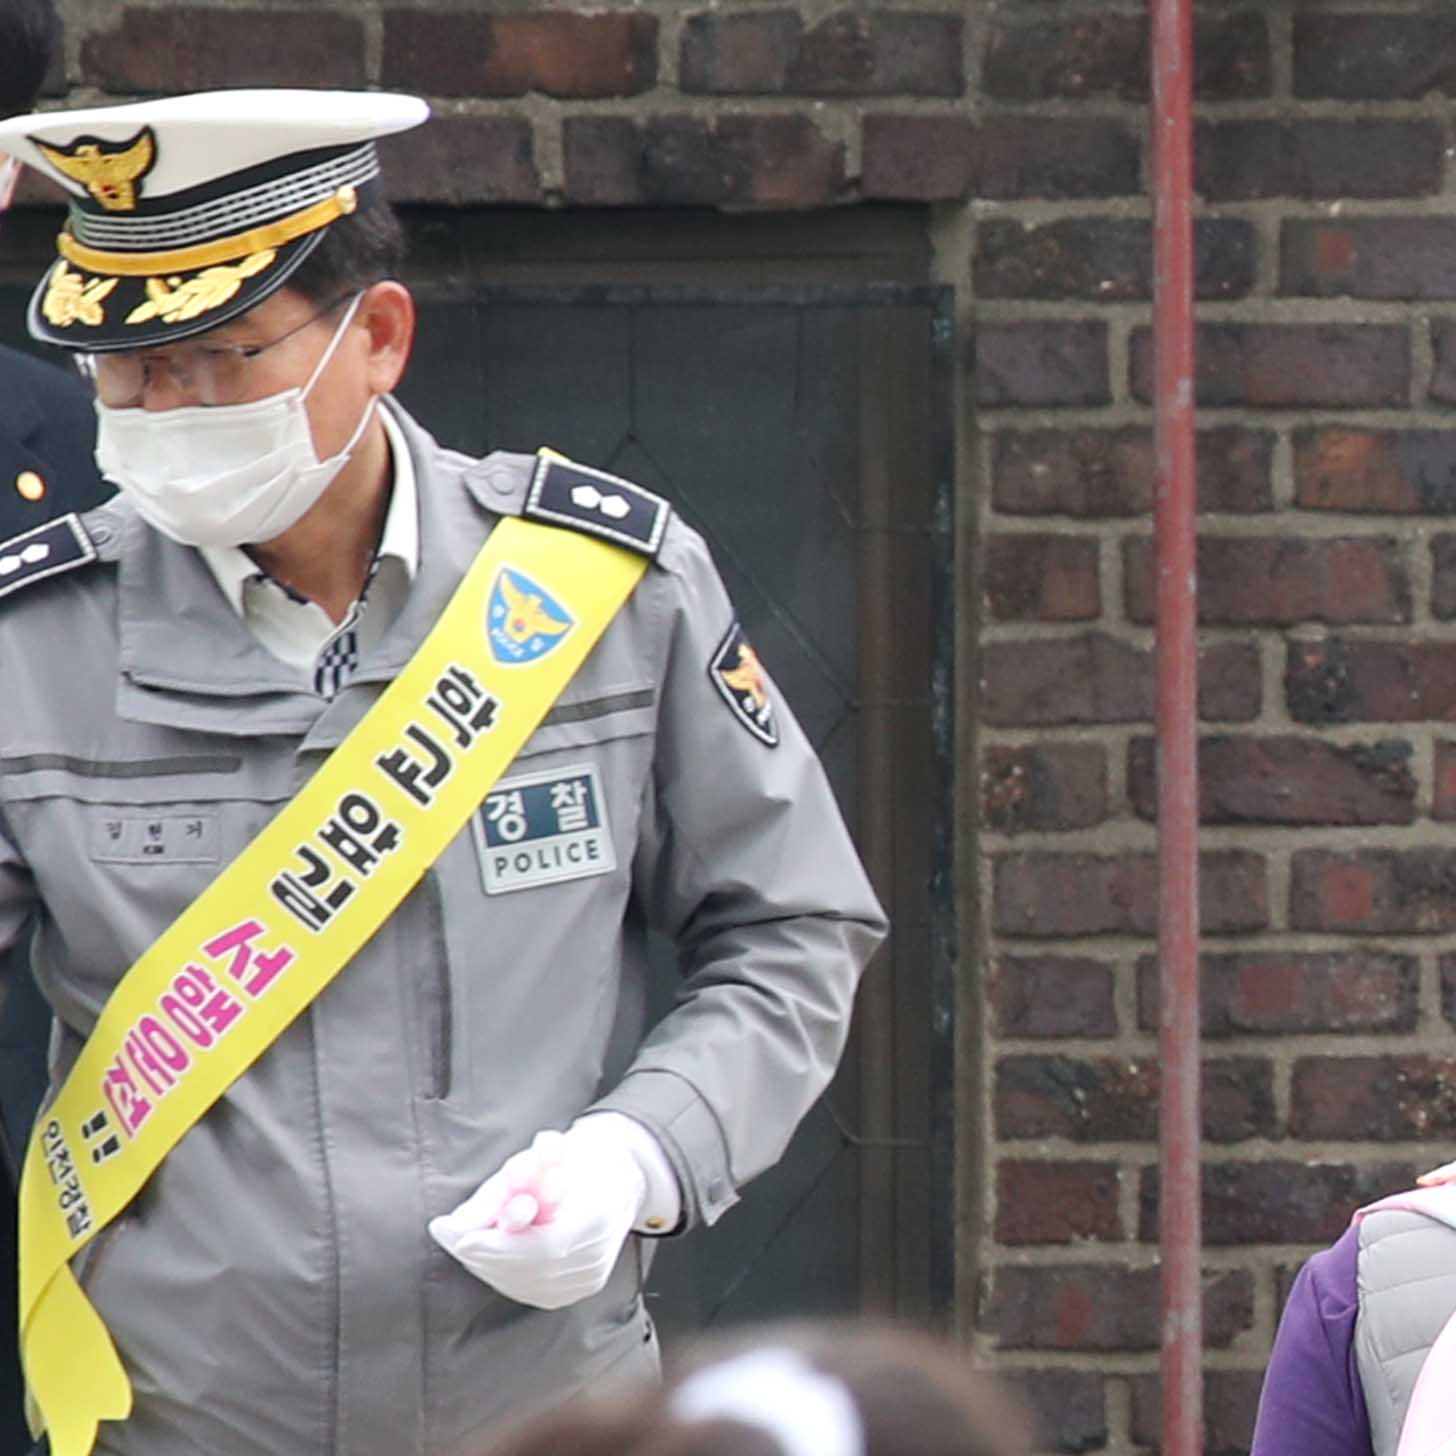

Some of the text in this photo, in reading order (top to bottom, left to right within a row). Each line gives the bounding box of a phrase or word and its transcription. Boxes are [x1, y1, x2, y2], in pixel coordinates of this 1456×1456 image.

[375, 666, 499, 806] 학교
[486, 780, 588, 841] 경찰
[494, 839, 600, 877] POLICE
[271, 792, 400, 932] 앞길
